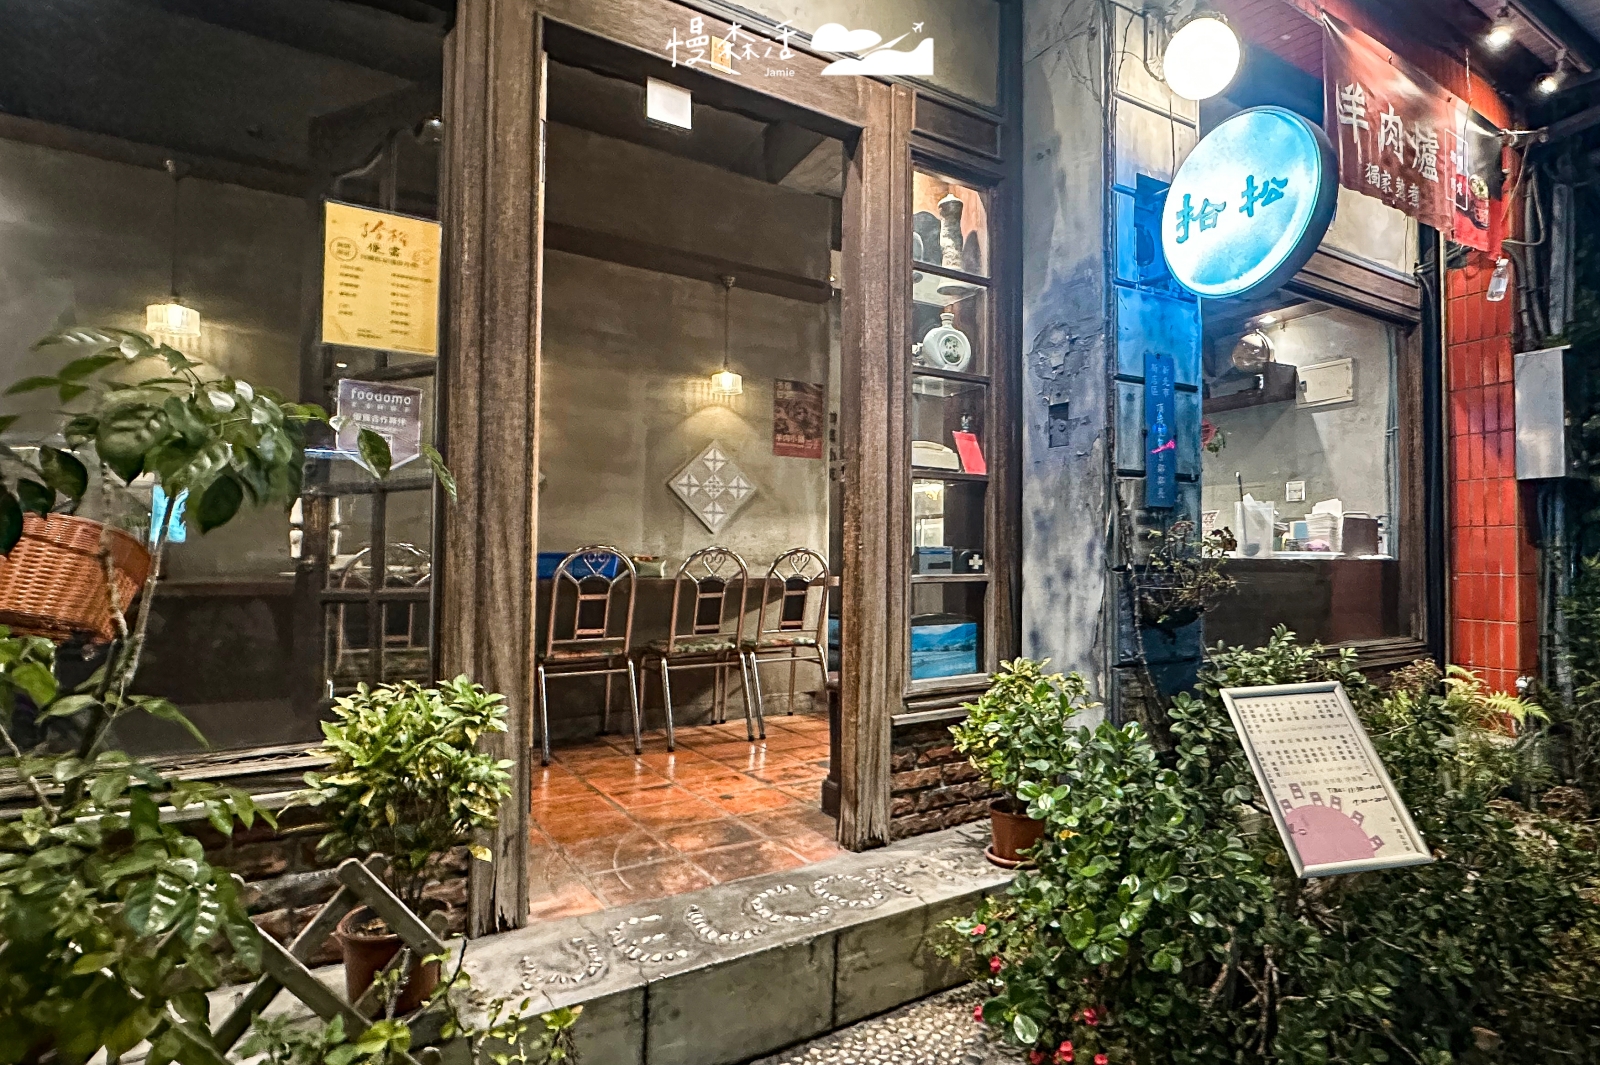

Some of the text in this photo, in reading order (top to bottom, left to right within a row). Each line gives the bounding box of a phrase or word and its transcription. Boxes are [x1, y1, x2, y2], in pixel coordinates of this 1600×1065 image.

[1340, 81, 1440, 184] 羊肉爐
[1175, 174, 1289, 244] 拾松
